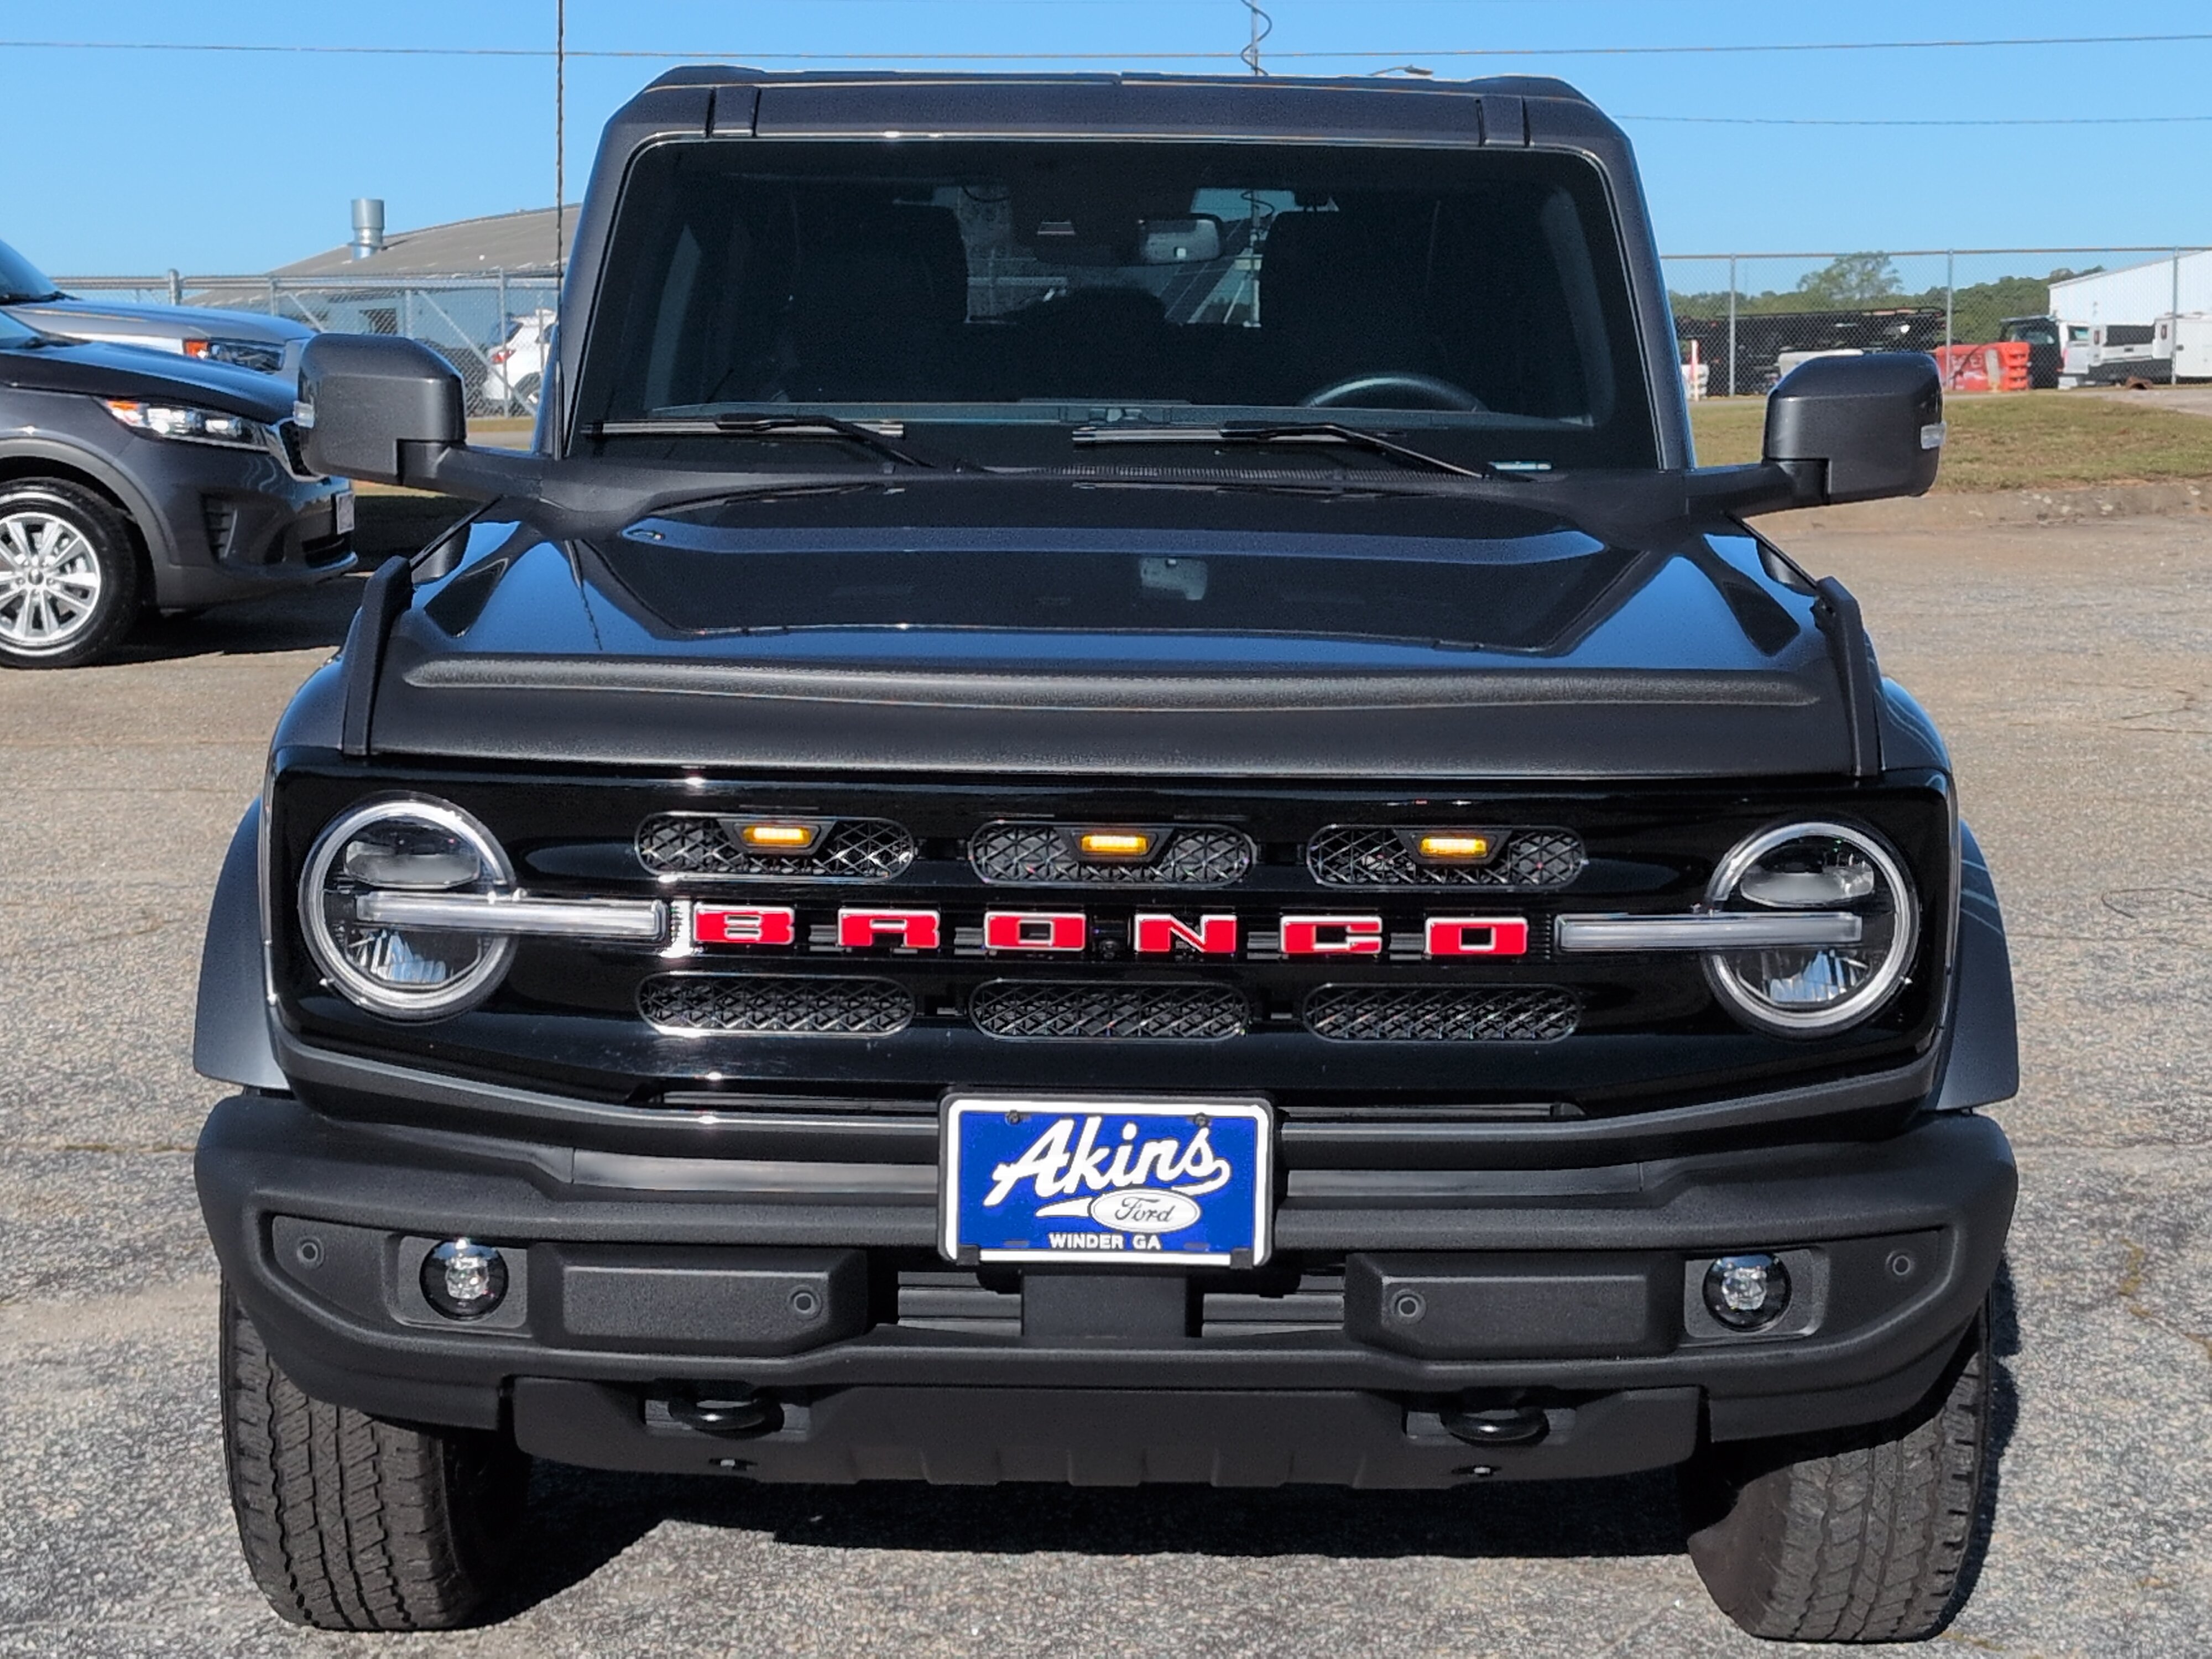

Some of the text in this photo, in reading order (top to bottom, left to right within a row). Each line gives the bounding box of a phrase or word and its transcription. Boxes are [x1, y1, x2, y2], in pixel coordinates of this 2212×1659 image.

[693, 903, 1528, 956] BRONCO
[983, 1115, 1232, 1207] Akins
[1114, 1196, 1176, 1222] Ford
[1048, 1233, 1161, 1250] WINDER GA
